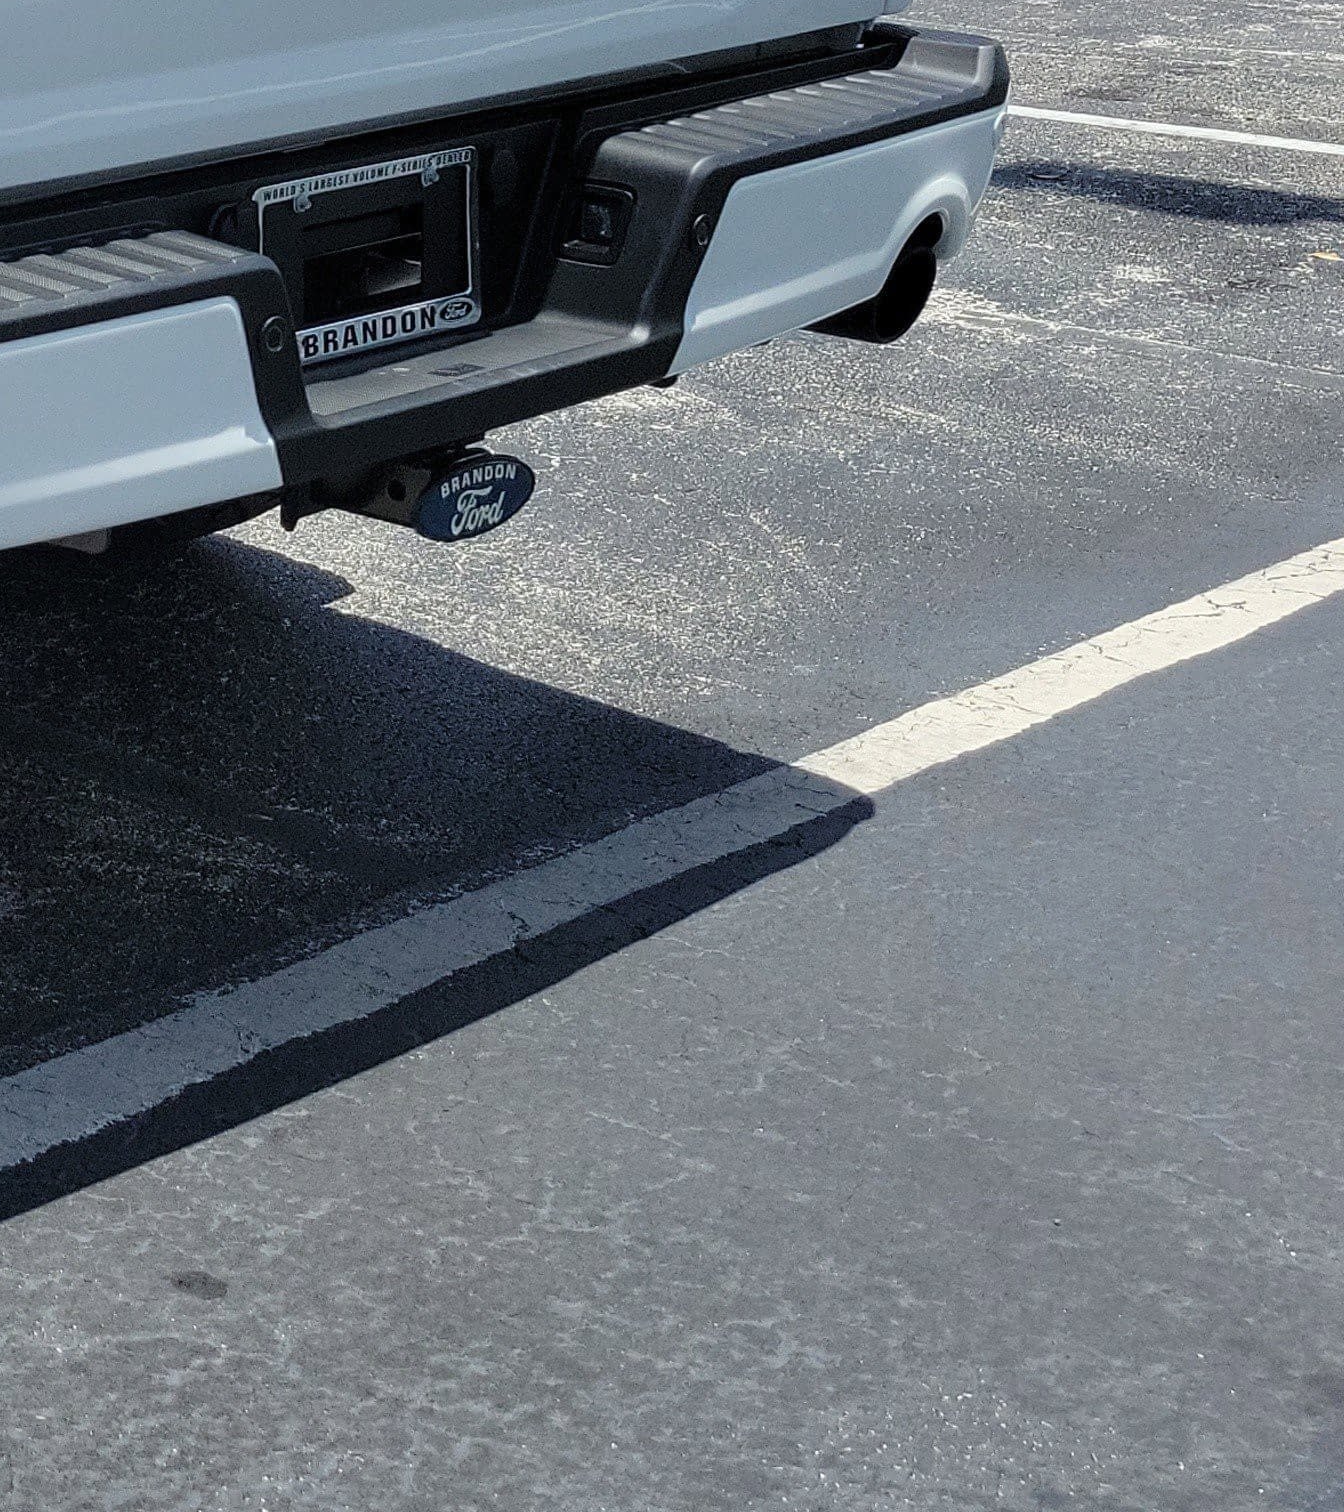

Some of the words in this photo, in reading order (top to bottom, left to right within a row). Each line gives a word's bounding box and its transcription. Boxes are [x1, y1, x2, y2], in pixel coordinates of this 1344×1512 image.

[309, 174, 349, 192] LARGEST
[353, 164, 388, 182] VOLUME
[301, 305, 437, 359] BRANDON
[440, 464, 516, 498] BRANDON
[451, 486, 506, 536] Ford
